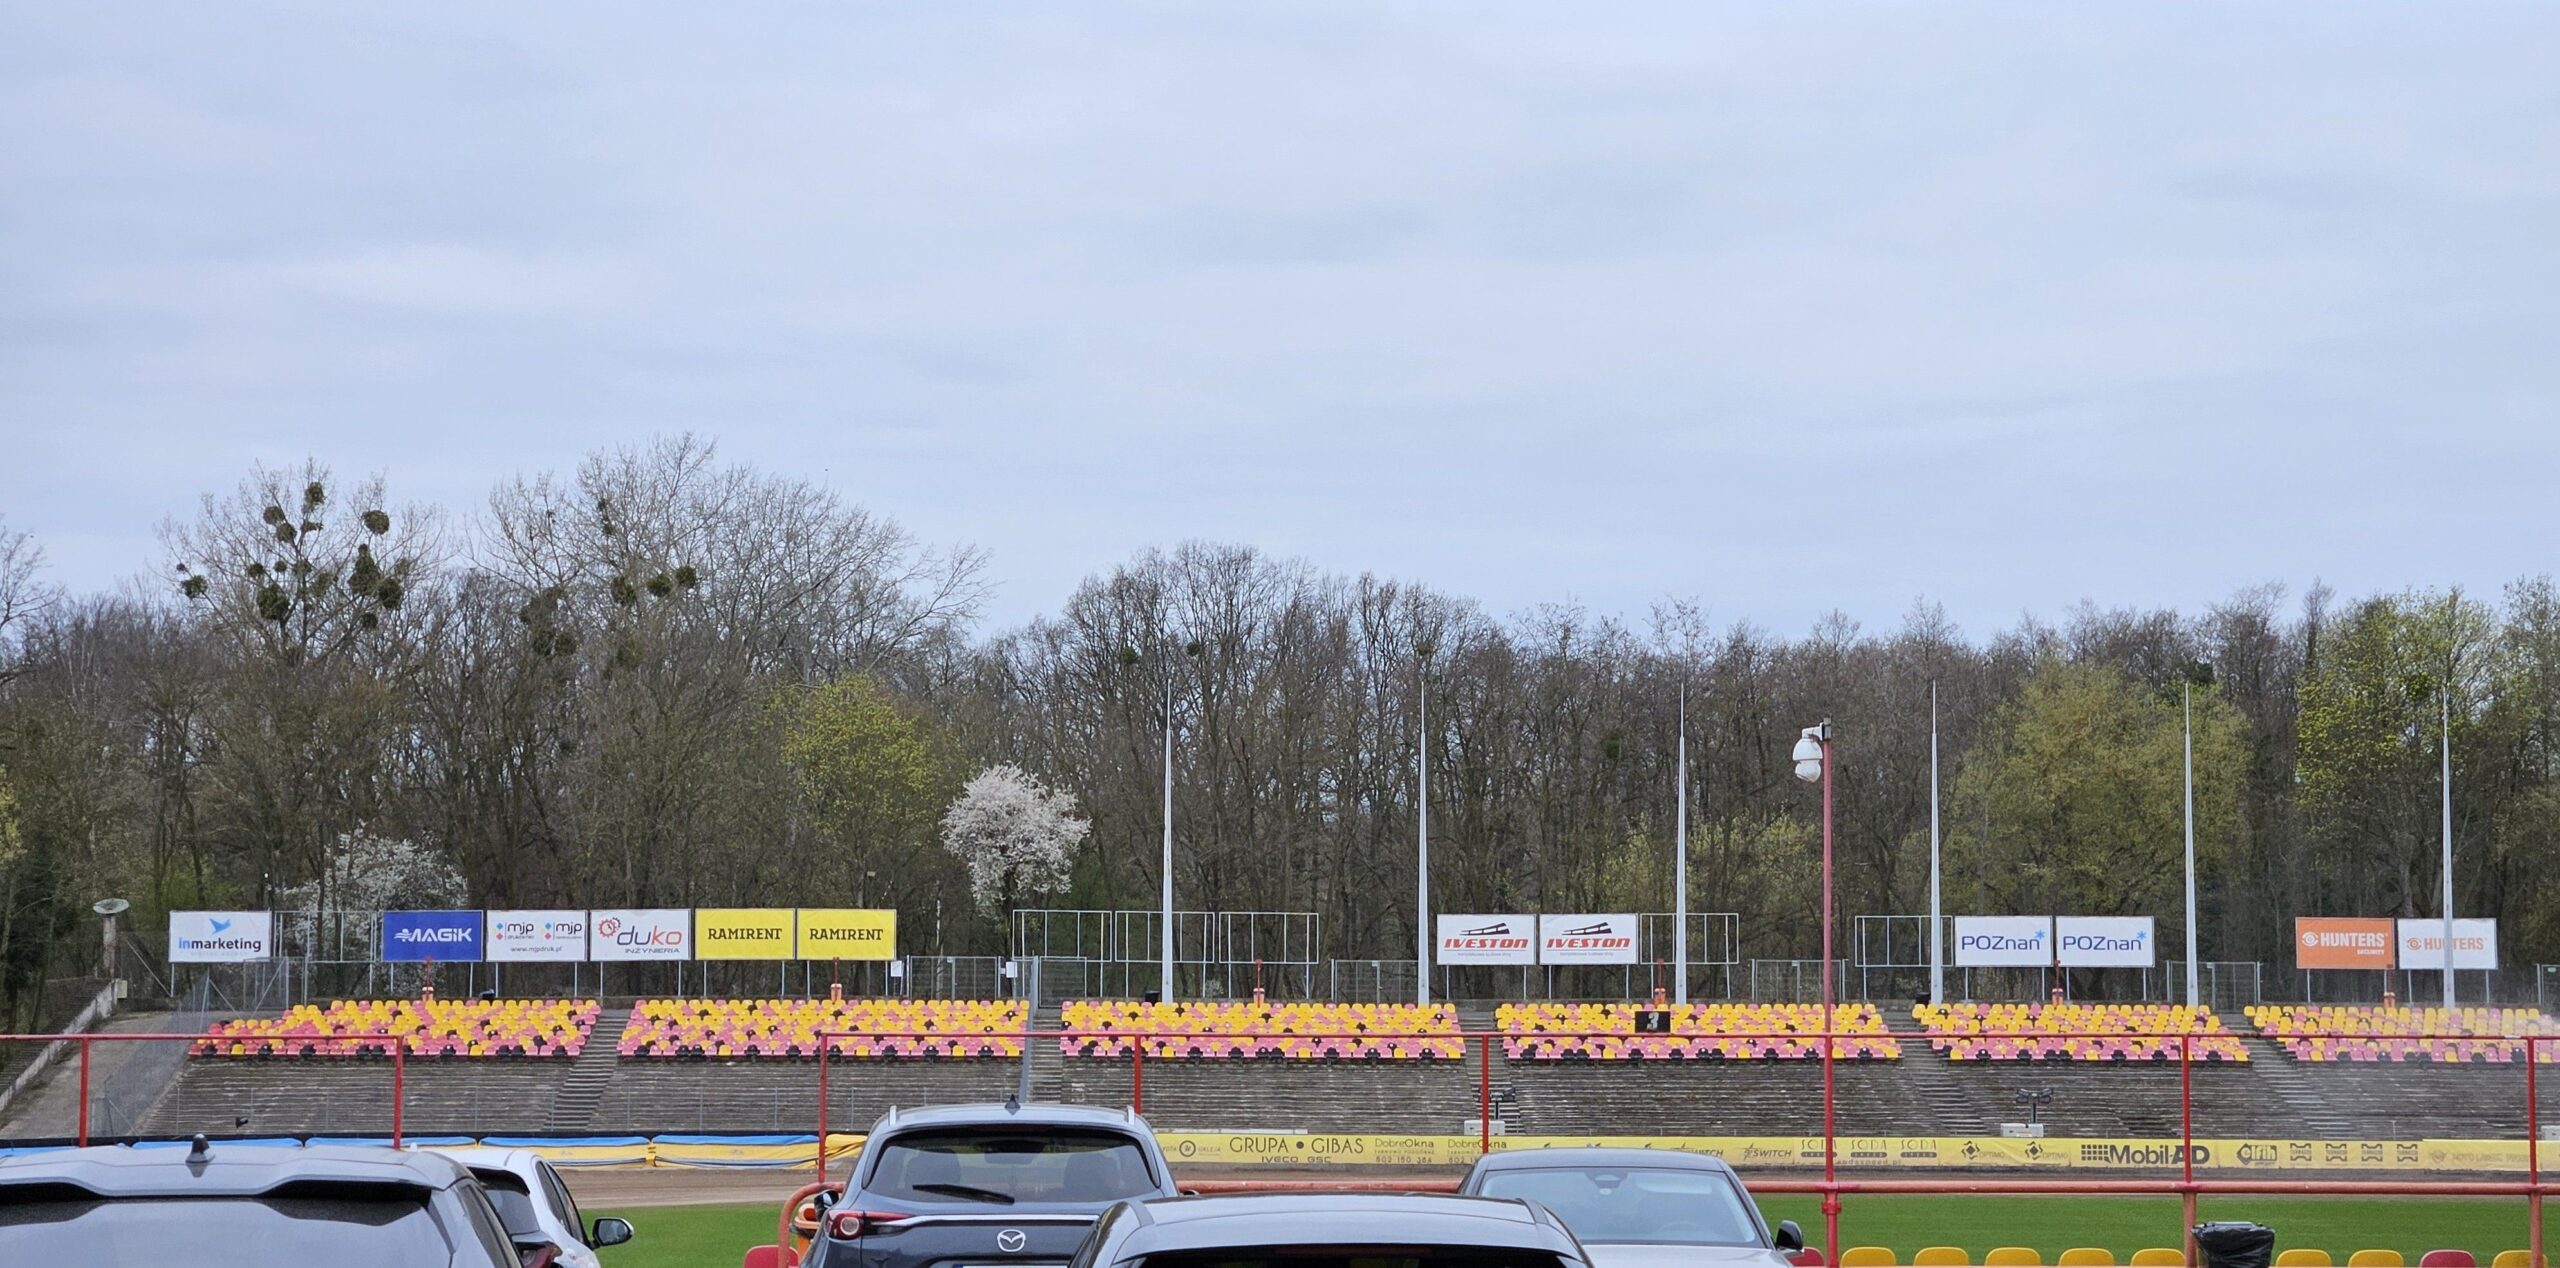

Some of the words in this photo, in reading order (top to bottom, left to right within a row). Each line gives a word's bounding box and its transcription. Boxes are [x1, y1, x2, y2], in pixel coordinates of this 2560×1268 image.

[508, 922, 534, 935] mjp
[556, 922, 582, 935] mjp
[617, 925, 682, 945] duko
[708, 928, 782, 940] RAMIRENT
[810, 928, 883, 941] RAMIRENT
[178, 937, 261, 952] inmarketing
[1444, 938, 1528, 949] IVESTON
[1546, 938, 1630, 949] IVESTON
[2320, 932, 2385, 947] HUNTERS
[2424, 938, 2484, 950] HUTERS
[1646, 1012, 1660, 1031] 3
[1230, 1136, 1289, 1153] GRUPA
[1311, 1137, 1364, 1154] GIBAS
[1375, 1138, 1434, 1148] DobreOkna
[1851, 1139, 1887, 1150] SODA
[1901, 1139, 1937, 1150] SODA
